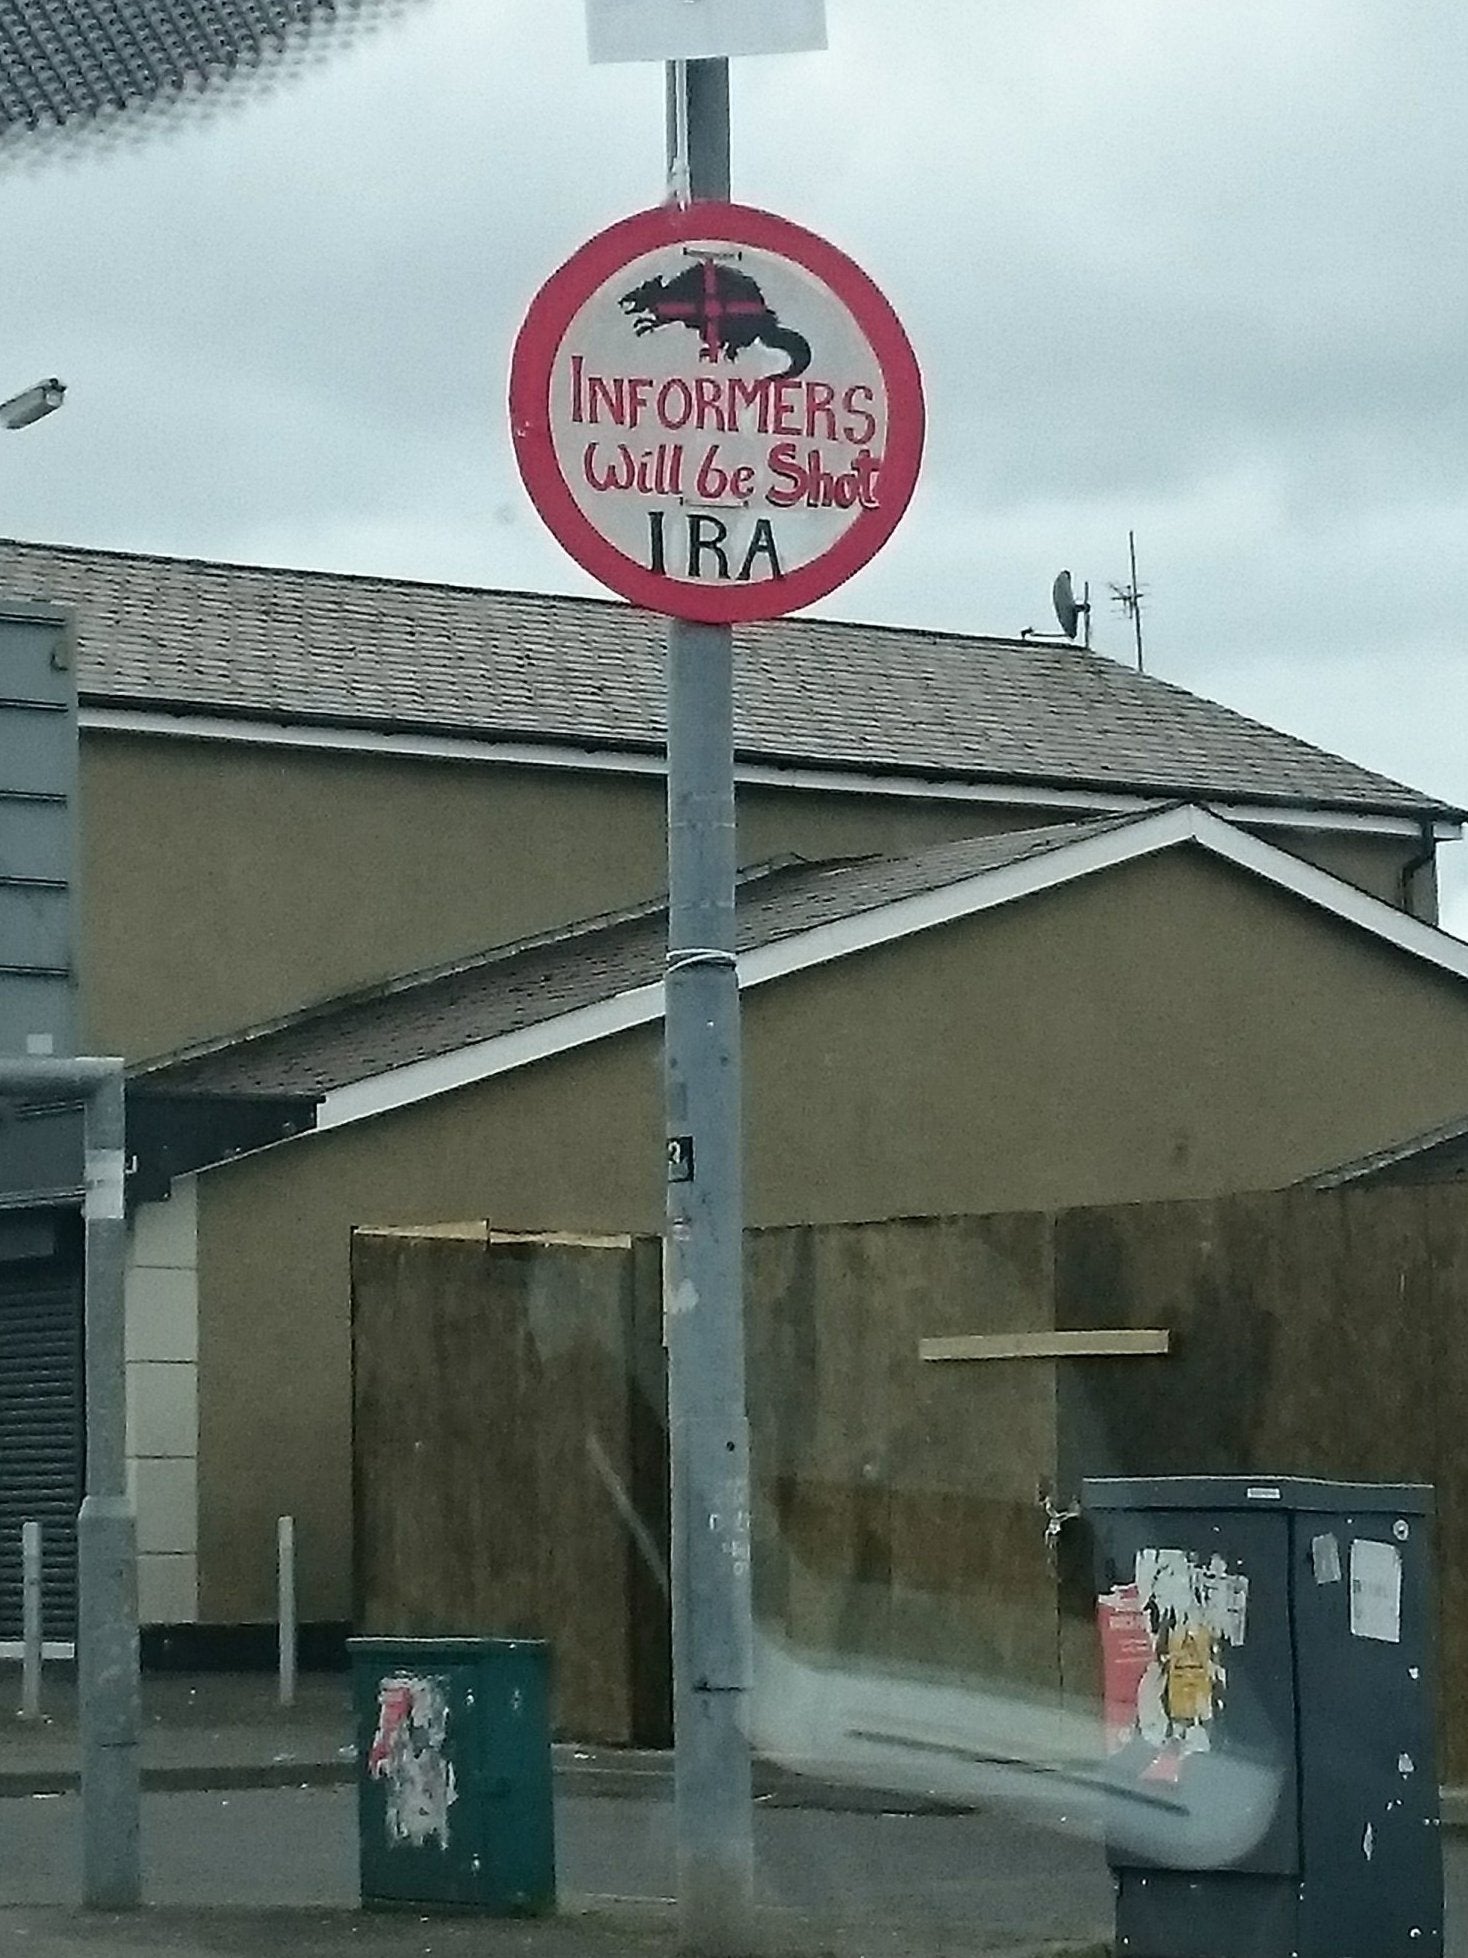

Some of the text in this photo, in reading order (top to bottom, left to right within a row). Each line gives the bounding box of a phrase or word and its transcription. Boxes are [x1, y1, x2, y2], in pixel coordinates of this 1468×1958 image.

[571, 355, 876, 444] INFORMERS
[584, 442, 882, 509] Will be Shot
[648, 511, 785, 581] IRA
